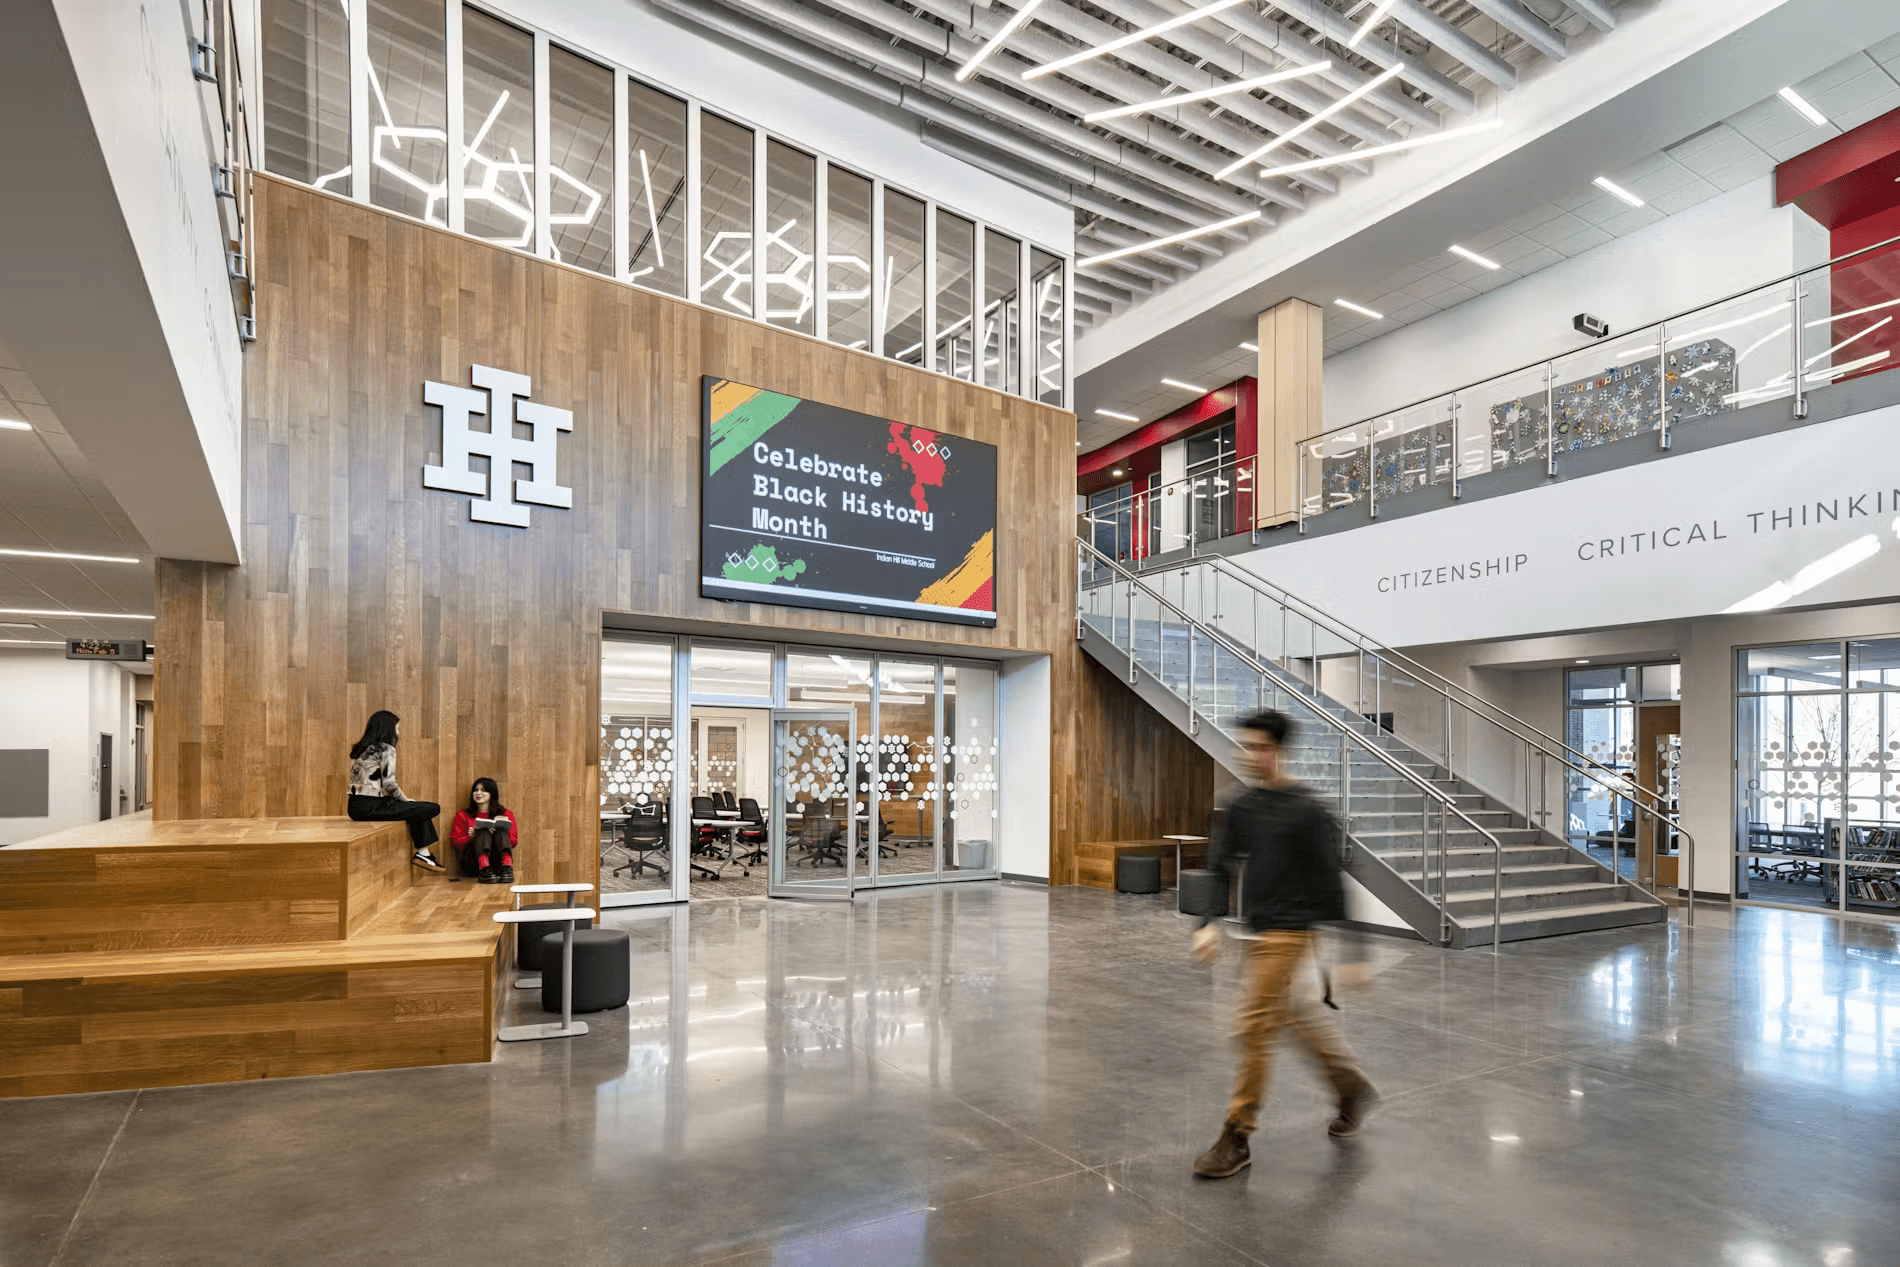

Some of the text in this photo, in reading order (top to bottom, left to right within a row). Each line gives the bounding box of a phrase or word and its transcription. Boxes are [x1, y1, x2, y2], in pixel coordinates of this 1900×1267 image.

[753, 441, 883, 487] Celebrate
[753, 474, 934, 531] Black History
[752, 507, 827, 539] Month
[1578, 520, 1727, 560] CRITICAL
[876, 553, 892, 562] Indian
[901, 557, 917, 566] Middle
[918, 560, 935, 569] School
[1377, 554, 1528, 592] CITIZENSHIP
